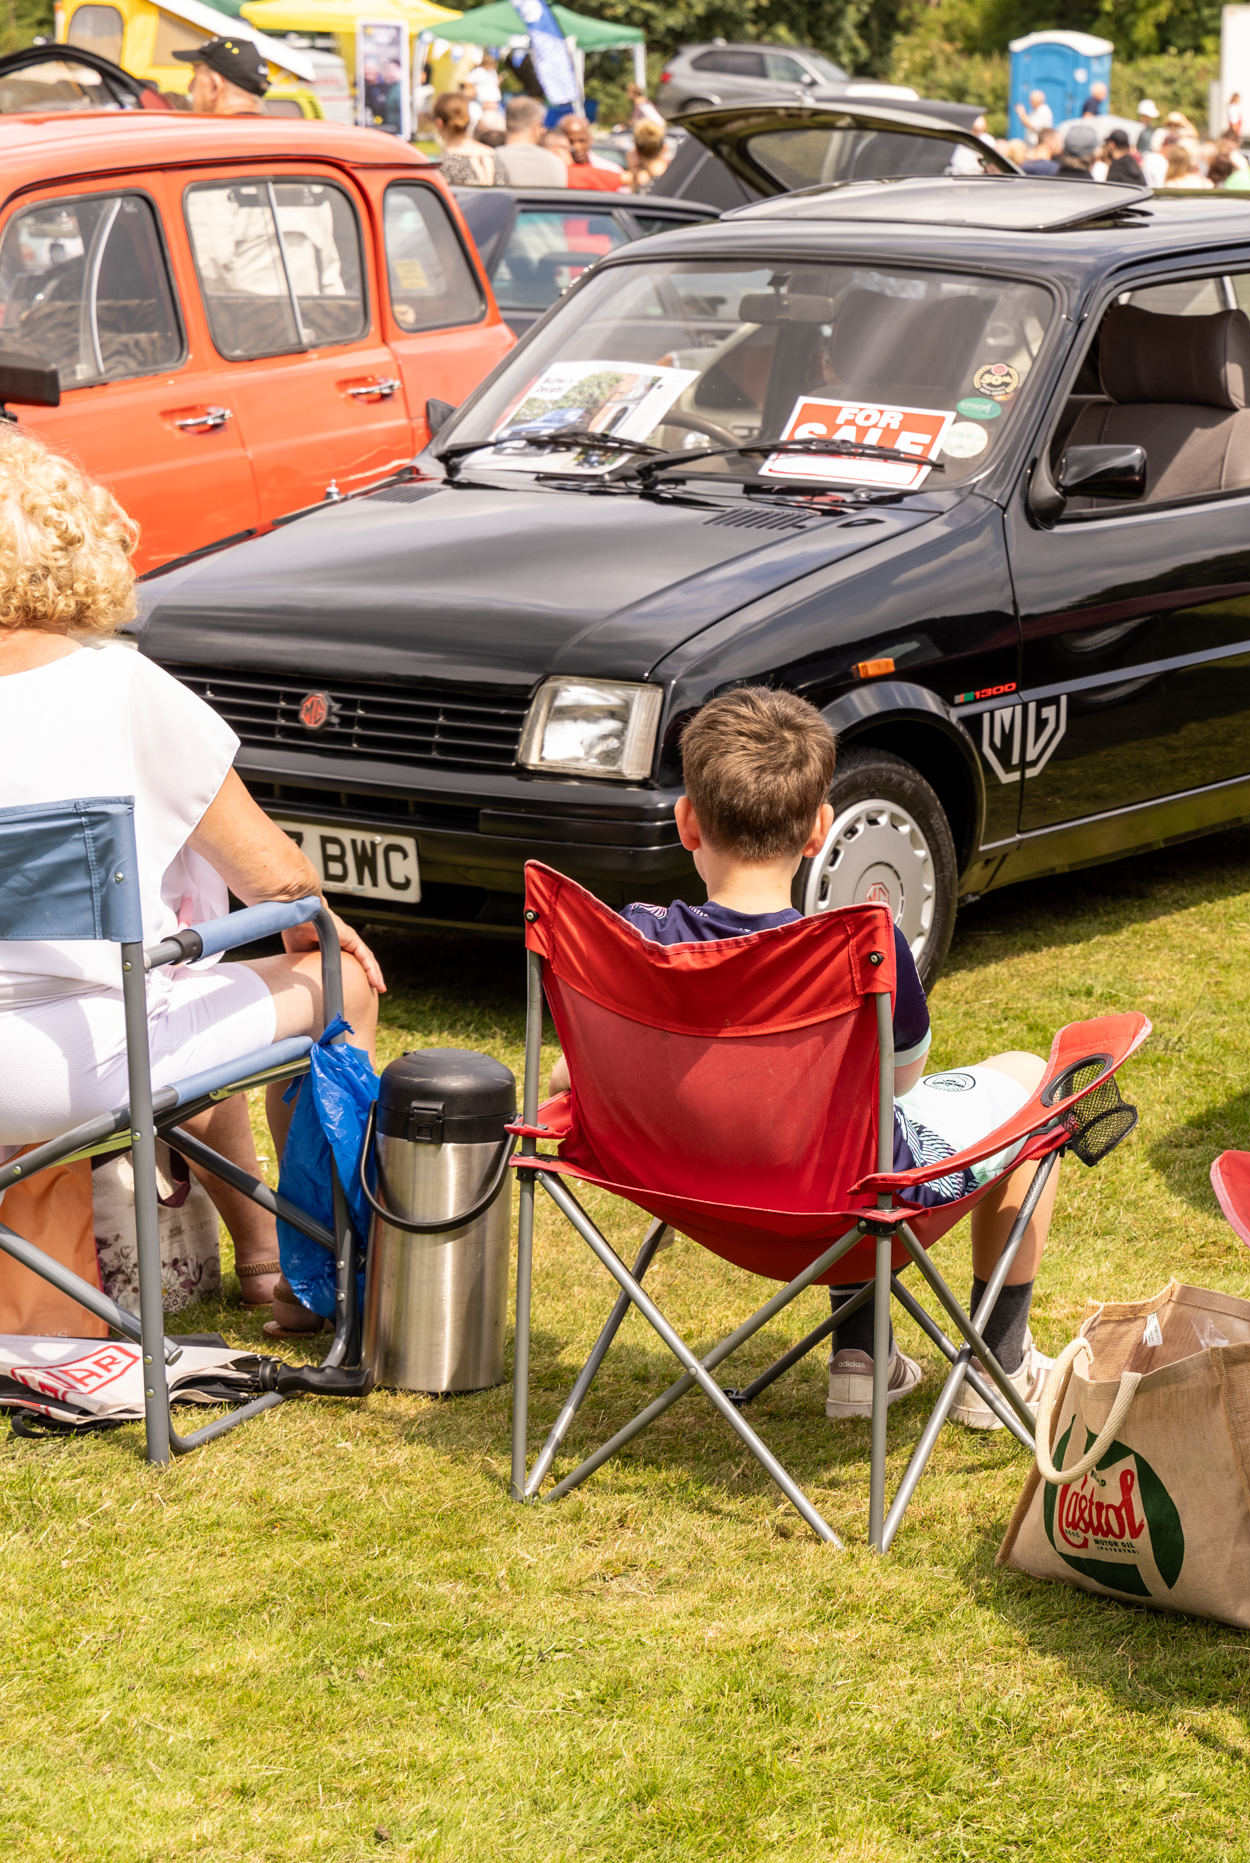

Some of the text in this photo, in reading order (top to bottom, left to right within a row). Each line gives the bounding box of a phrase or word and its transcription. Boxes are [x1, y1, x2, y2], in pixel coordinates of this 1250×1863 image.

[835, 407, 904, 430] FOR
[974, 682, 1017, 699] 1300
[302, 695, 328, 727] MG
[319, 834, 411, 891] BWC
[838, 1360, 866, 1368] adidas
[1058, 1469, 1145, 1549] Castrol
[1093, 1538, 1136, 1549] MOTOR OIL
